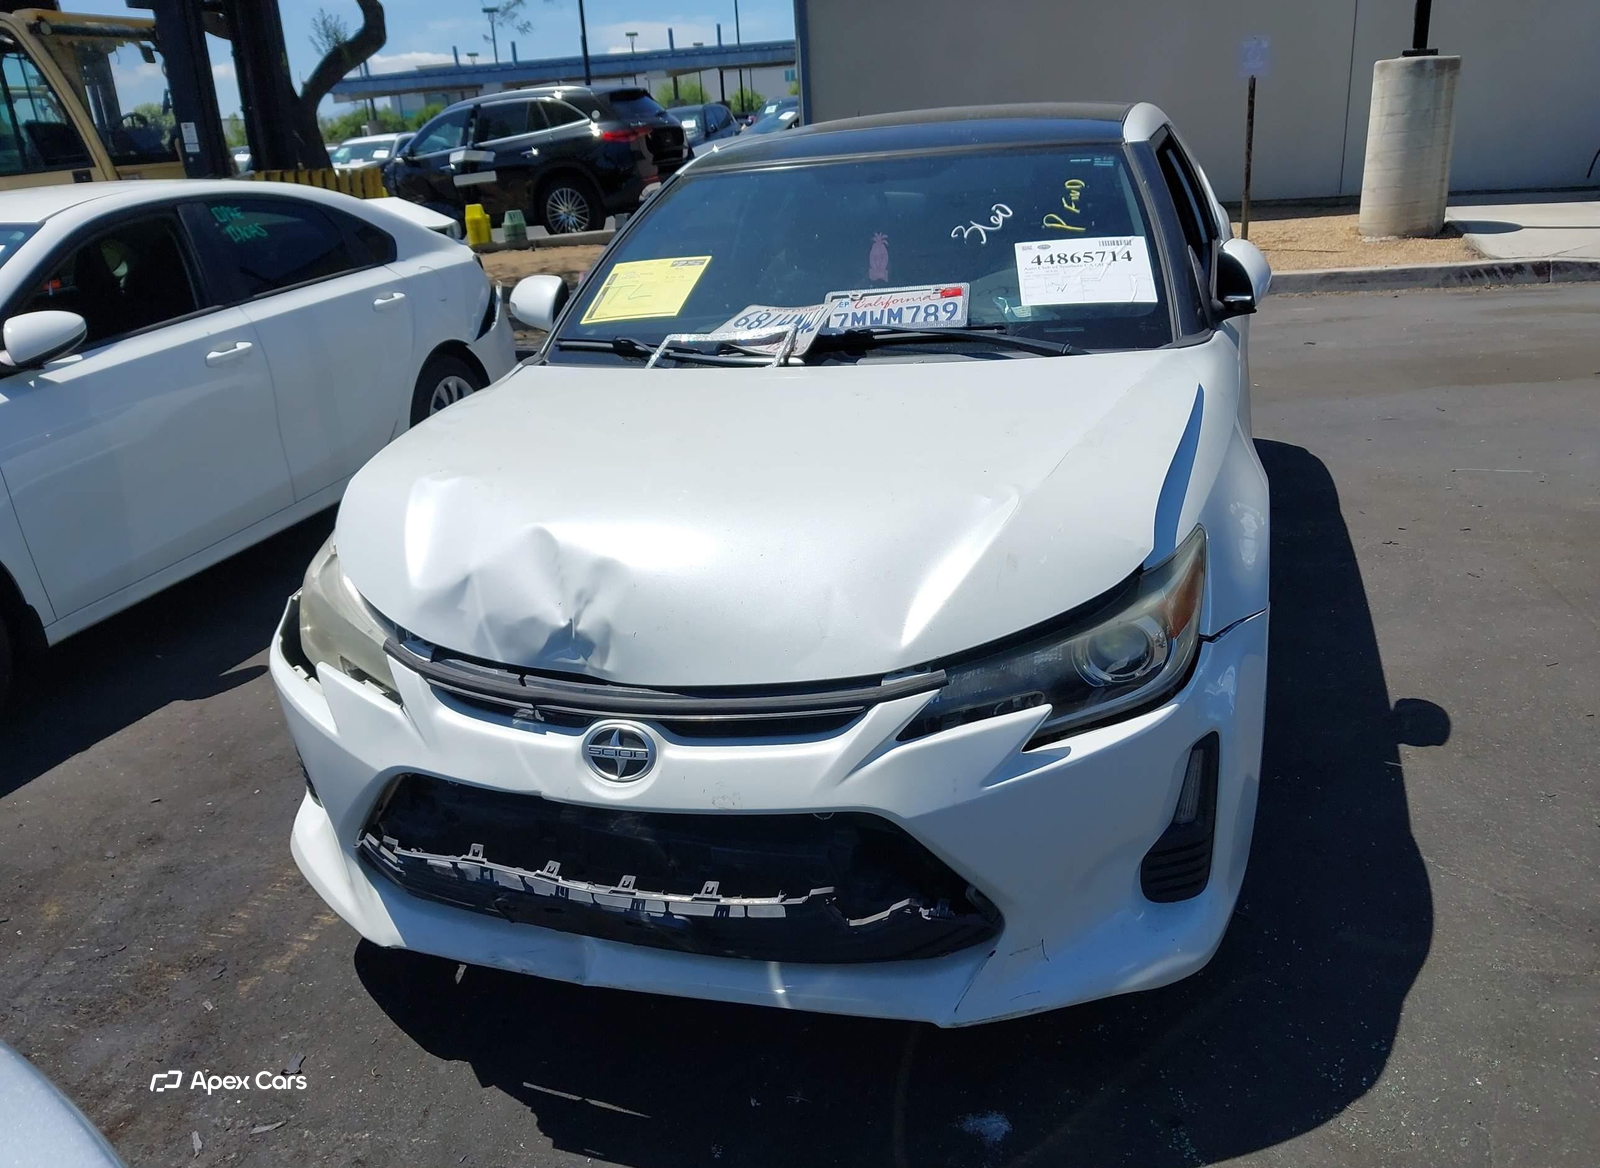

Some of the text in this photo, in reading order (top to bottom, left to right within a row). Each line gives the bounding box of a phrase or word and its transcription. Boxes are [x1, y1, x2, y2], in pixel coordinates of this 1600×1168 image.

[1030, 250, 1133, 266] 44865714
[854, 294, 935, 310] California
[833, 301, 958, 327] 7MWM789
[588, 746, 649, 760] SCION
